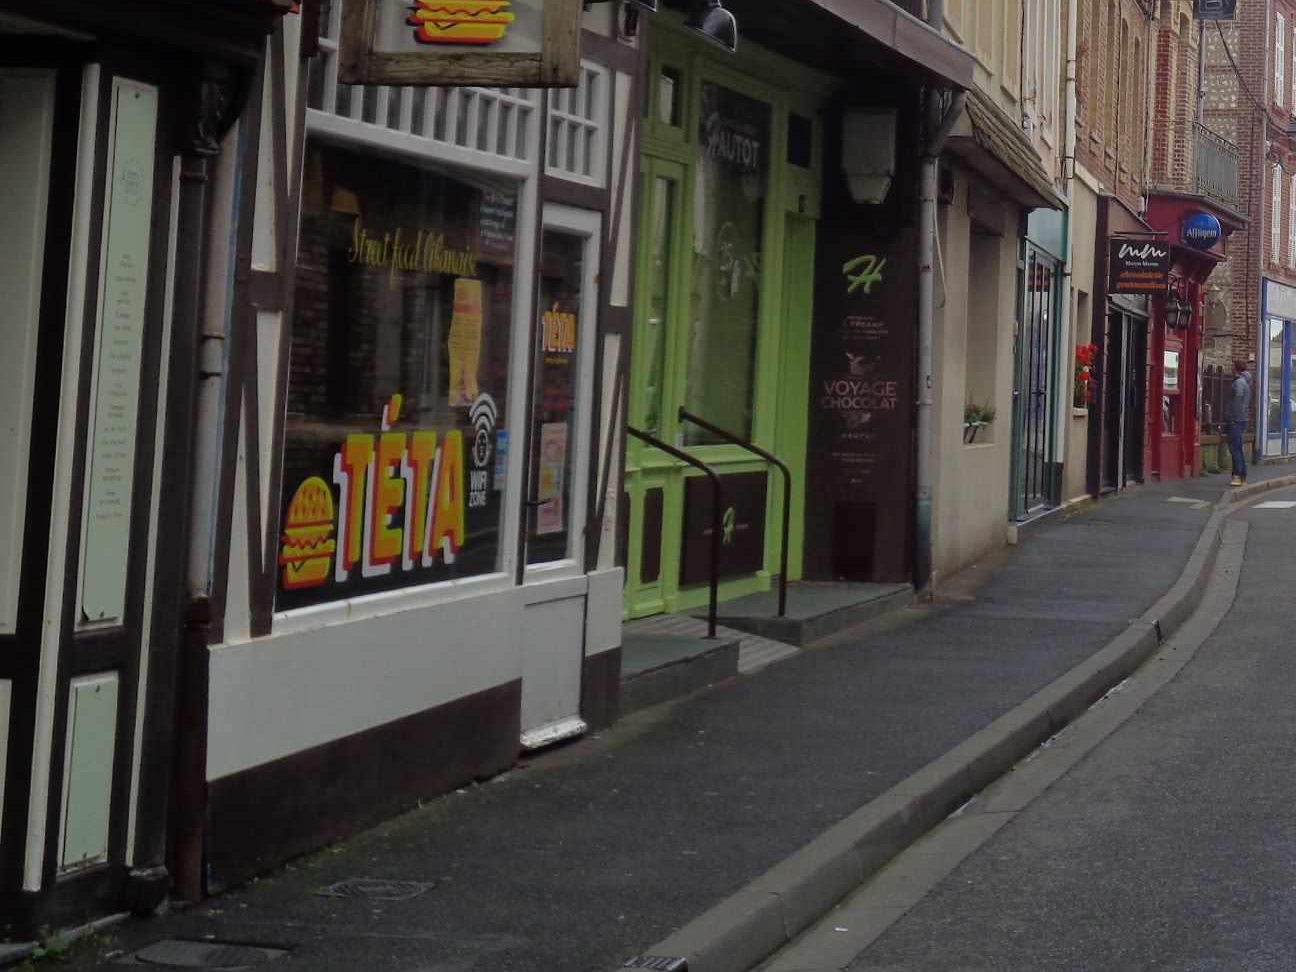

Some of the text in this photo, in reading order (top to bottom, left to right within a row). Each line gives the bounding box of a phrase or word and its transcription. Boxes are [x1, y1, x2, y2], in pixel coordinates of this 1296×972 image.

[1186, 228, 1217, 240] Affligem
[541, 300, 577, 352] TÉTA
[823, 380, 897, 396] VOYAGE
[820, 396, 898, 409] CHOCOLAT
[332, 394, 466, 582] TÉTA
[468, 491, 487, 508] ZONE
